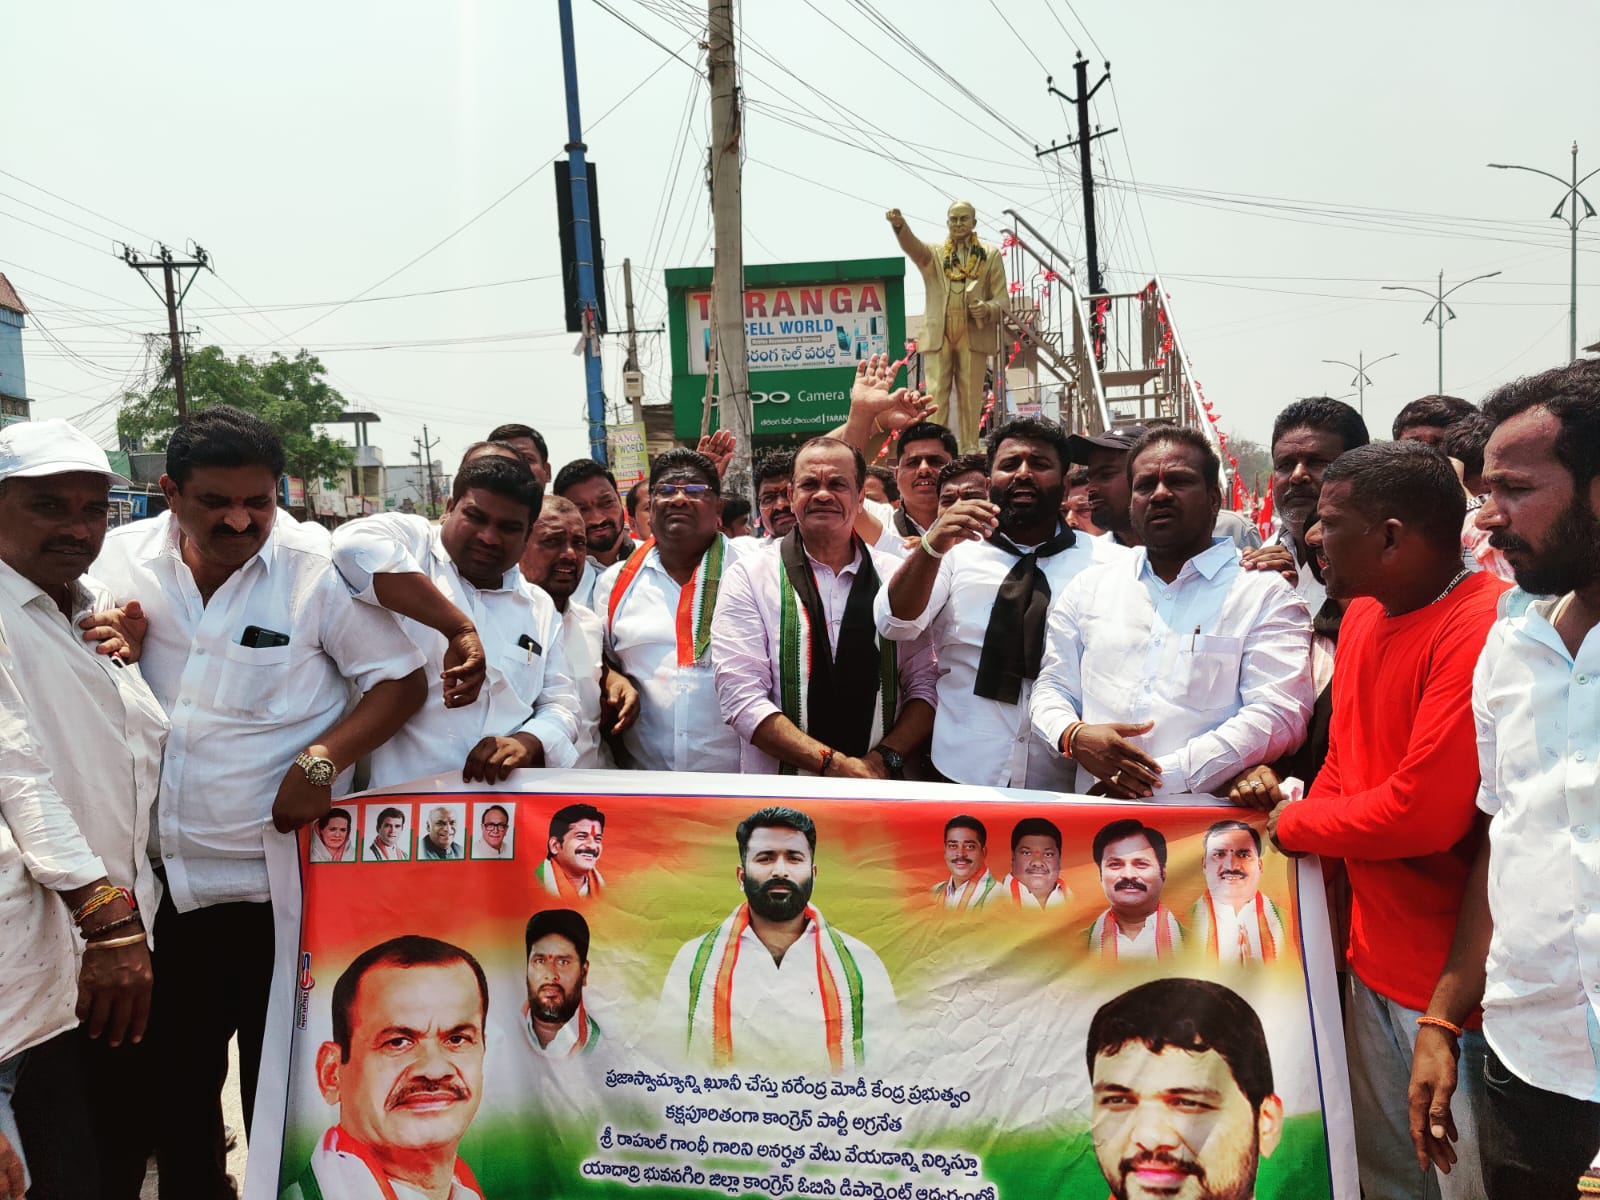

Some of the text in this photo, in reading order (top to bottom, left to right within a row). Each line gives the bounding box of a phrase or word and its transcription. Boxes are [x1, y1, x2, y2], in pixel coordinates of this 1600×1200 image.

[693, 286, 882, 320] TRANGA
[780, 318, 834, 334] WORLD
[797, 389, 845, 402] Camera
[605, 1069, 702, 1094] ప్రజాస్వామ్యాన్ని
[704, 1073, 742, 1093] ఖూనీ
[782, 1076, 827, 1100] నరేంద్ర
[831, 1077, 867, 1097] మోడీ
[871, 1079, 906, 1104] కేంద్ర
[908, 1084, 971, 1108] ప్రభుత్వం
[665, 1104, 903, 1136] కక్షపూరితంగా కాంగ్రెస్ పార్టీ అగ్రనేత
[600, 1126, 614, 1149] శ్రీ
[617, 1132, 668, 1150] రాహుల్
[670, 1134, 709, 1155] గాంధీ
[713, 1140, 753, 1156] గారిని
[757, 1143, 806, 1168] అనర్హత
[809, 1142, 842, 1162] వేటు
[844, 1145, 921, 1174] వేయడాన్ని
[582, 1160, 641, 1183] యాదాద్రి
[643, 1165, 705, 1185] భువనగిరి
[709, 1173, 740, 1193] జిల్లా
[743, 1175, 794, 1196] కాంగ్రెస్
